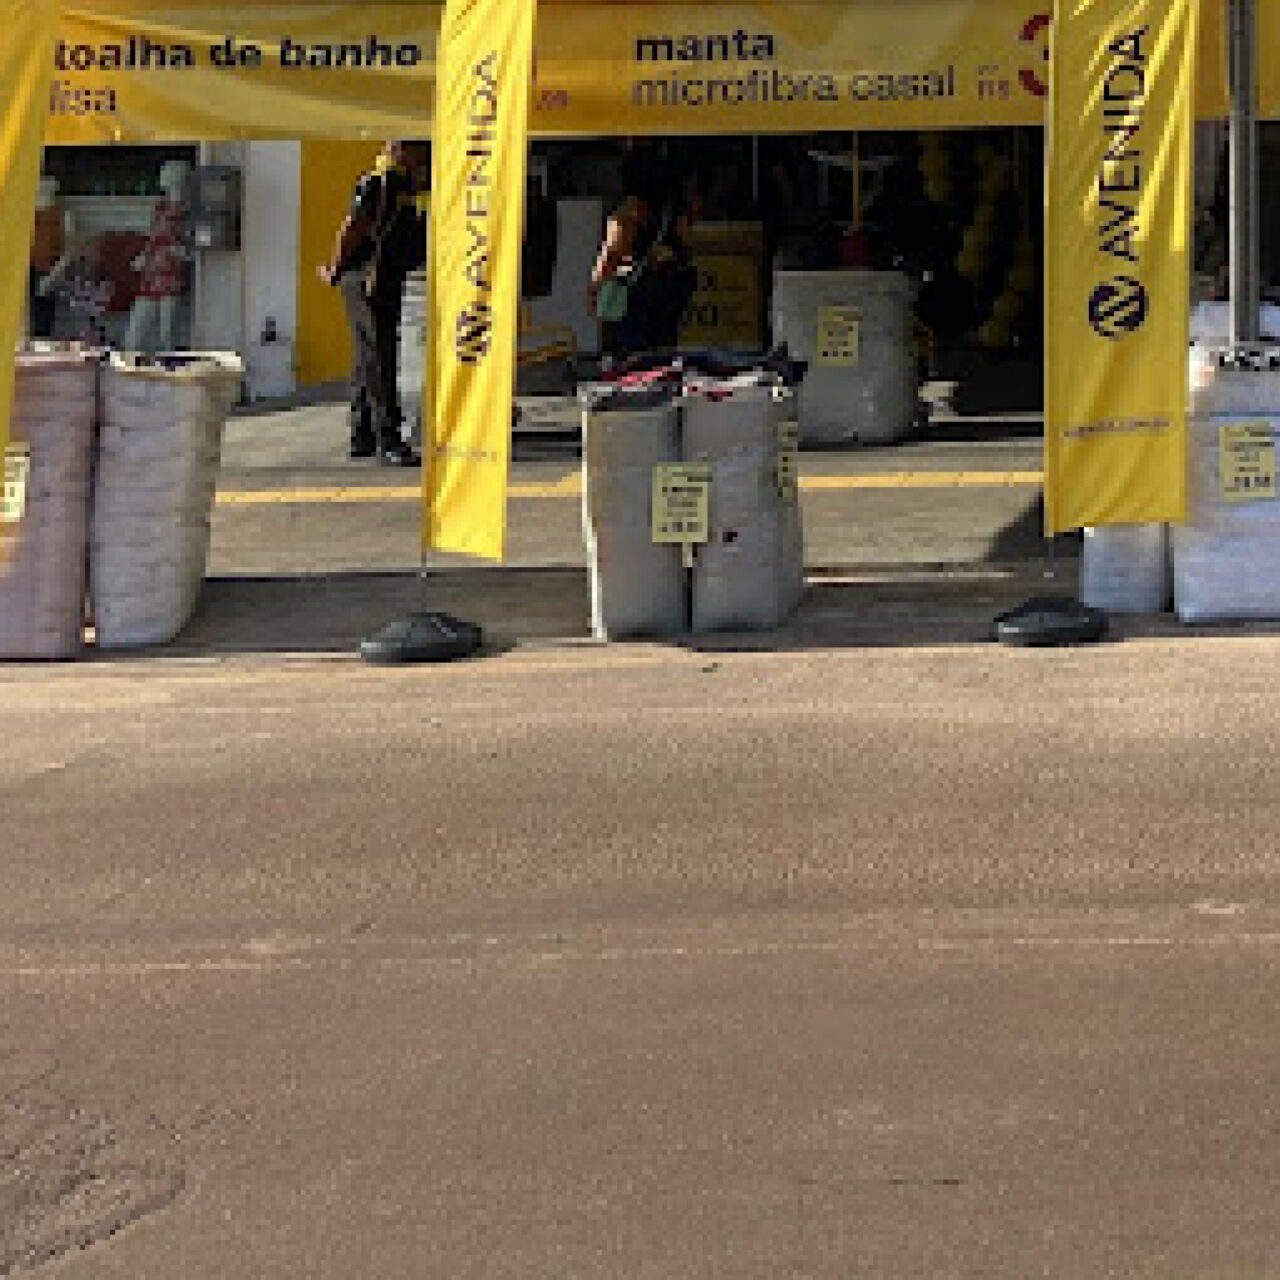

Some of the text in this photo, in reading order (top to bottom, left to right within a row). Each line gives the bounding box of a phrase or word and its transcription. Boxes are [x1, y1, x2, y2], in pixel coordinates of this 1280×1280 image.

[55, 35, 423, 70] toalha de banho
[634, 29, 775, 61] manta
[632, 67, 839, 105] microfibra
[849, 64, 955, 102] casal
[1099, 24, 1149, 262] AVENIDA
[464, 50, 497, 292] AVENIDA
